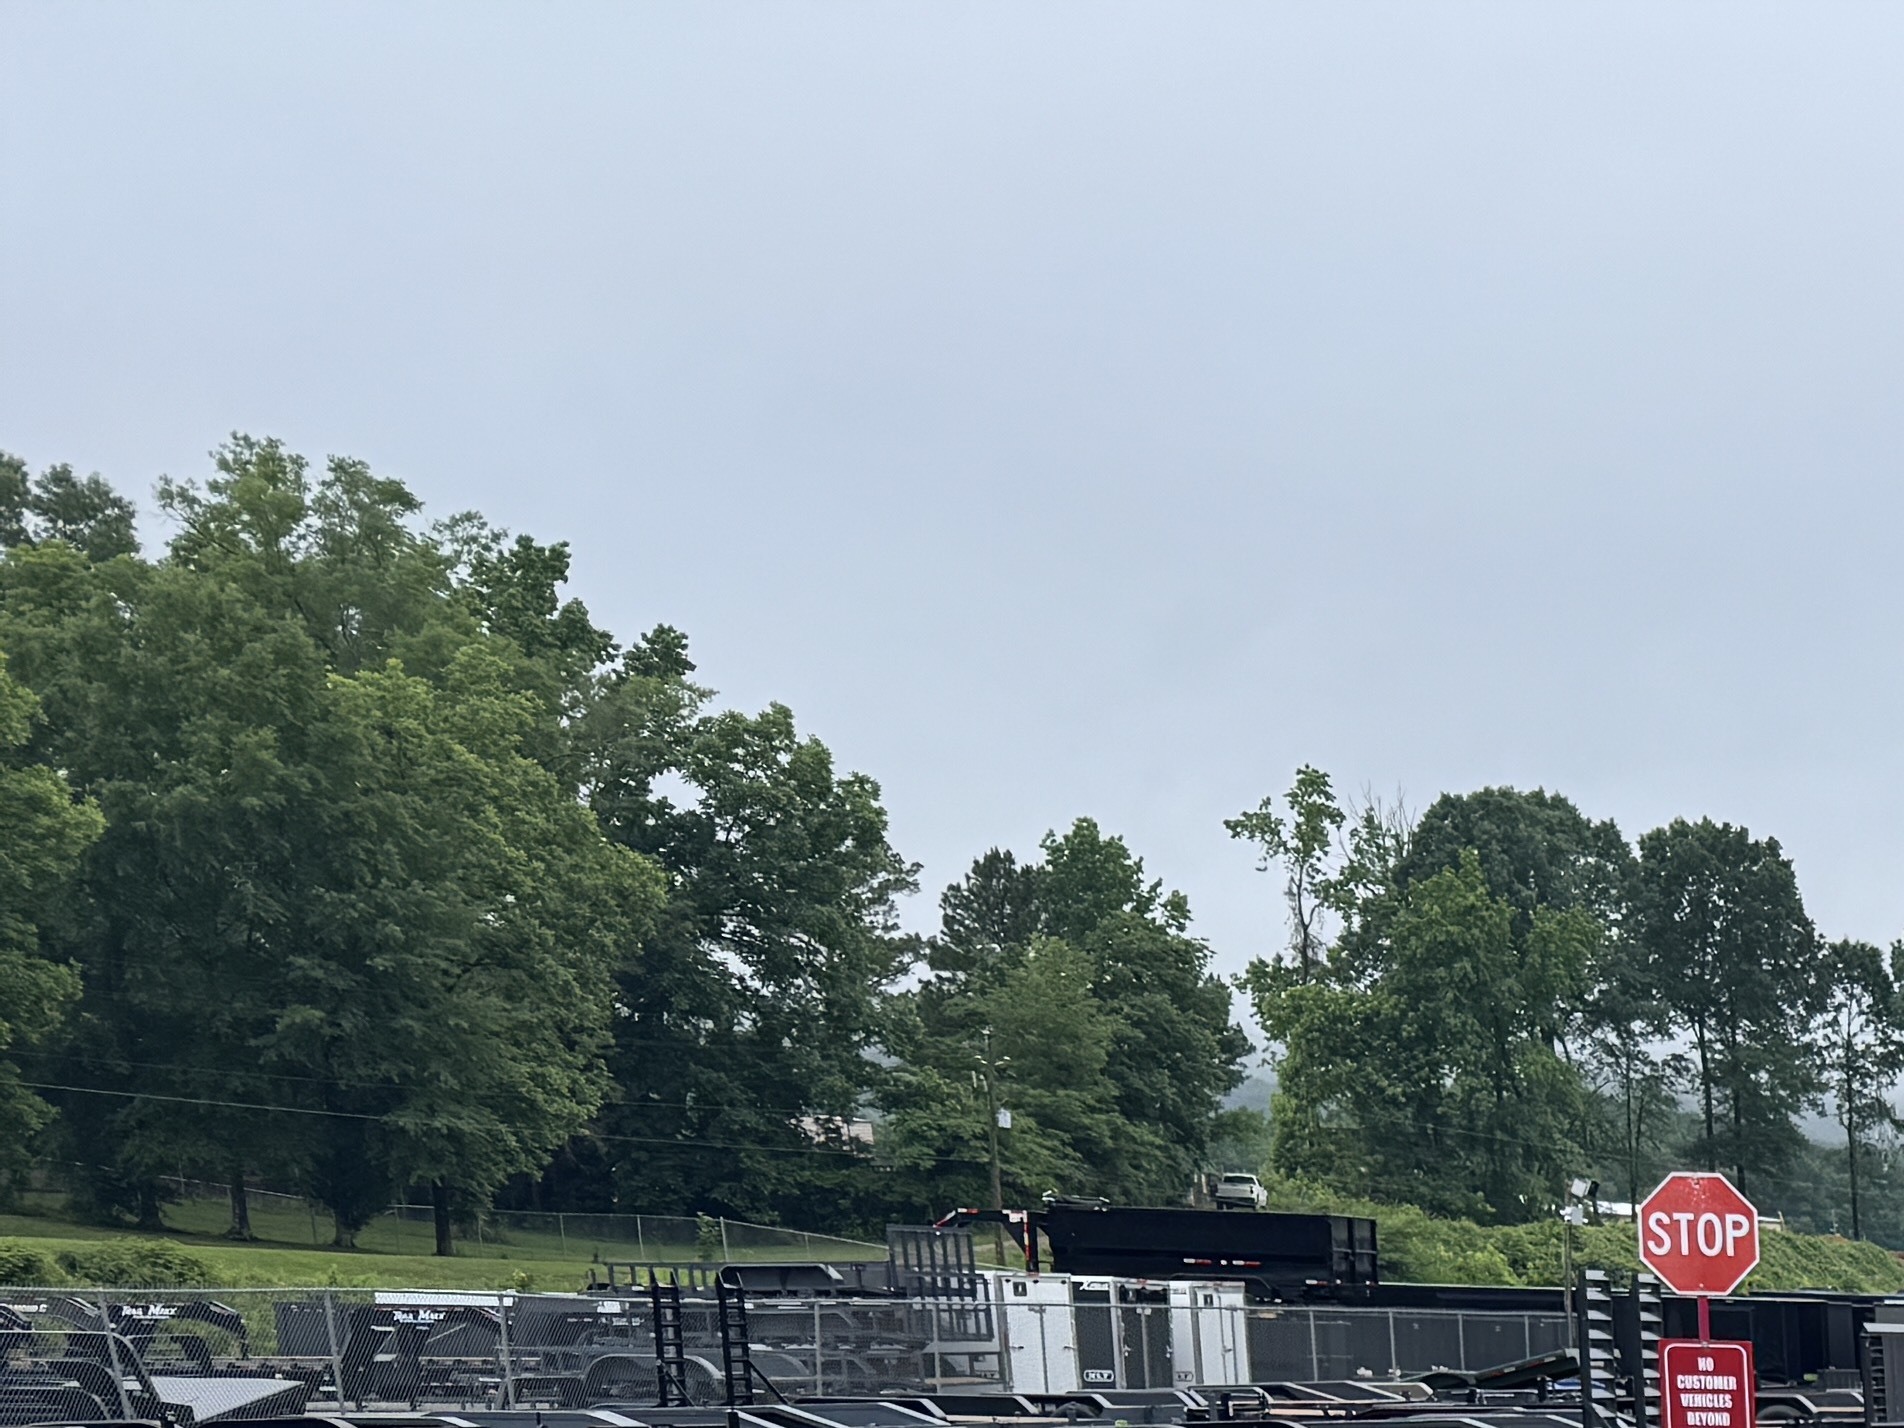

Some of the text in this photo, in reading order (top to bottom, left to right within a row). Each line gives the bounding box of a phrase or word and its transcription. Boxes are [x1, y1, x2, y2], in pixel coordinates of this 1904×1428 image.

[1647, 1211, 1750, 1257] STOP
[1697, 1357, 1715, 1372] NO
[1677, 1375, 1737, 1390] CUSTOMER
[1680, 1393, 1733, 1409] VEHICLES
[1687, 1411, 1731, 1427] BEYOND
